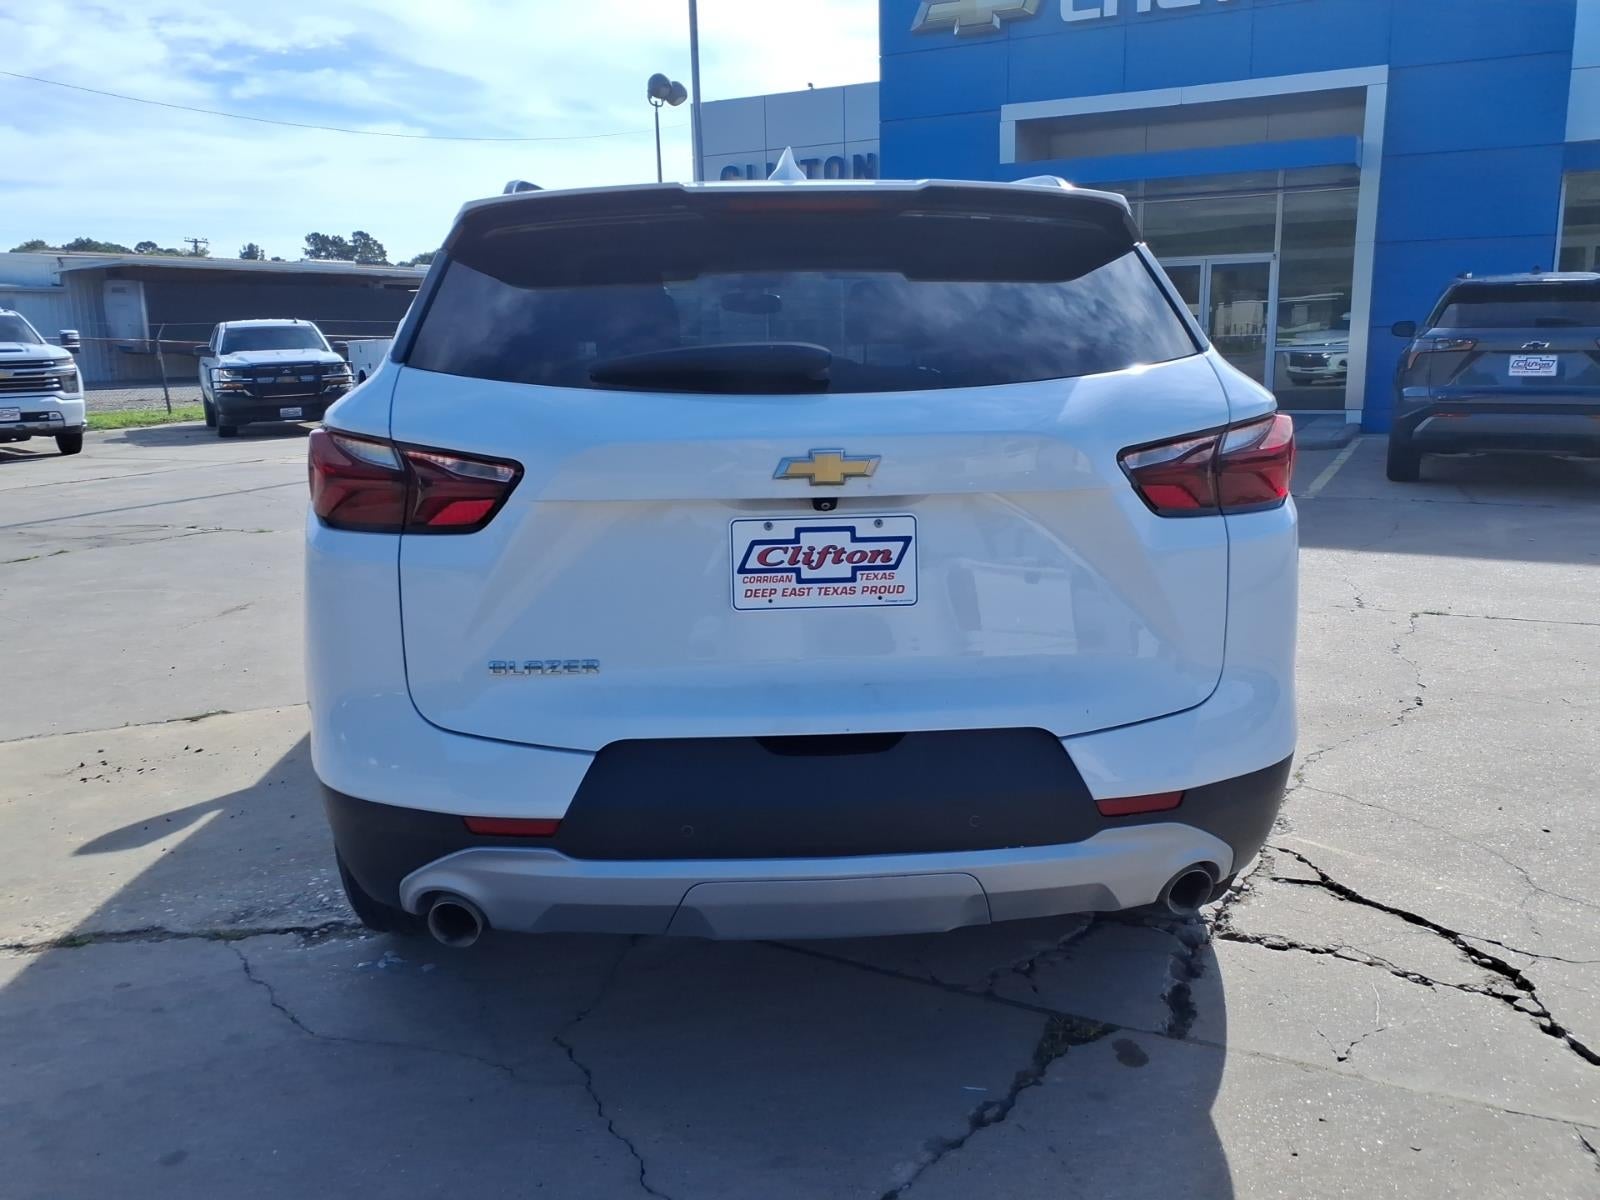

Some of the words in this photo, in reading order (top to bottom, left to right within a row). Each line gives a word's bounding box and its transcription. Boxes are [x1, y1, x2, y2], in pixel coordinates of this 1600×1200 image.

[720, 153, 877, 180] CLITON
[757, 544, 893, 570] Clifton
[742, 574, 793, 584] CORRIGAN
[859, 572, 895, 581] TEXAS
[744, 587, 777, 598] DEEP
[782, 587, 812, 597] EAST
[817, 586, 856, 596] TEXAS
[861, 585, 905, 595] PROUD
[488, 659, 600, 675] BLAZER
